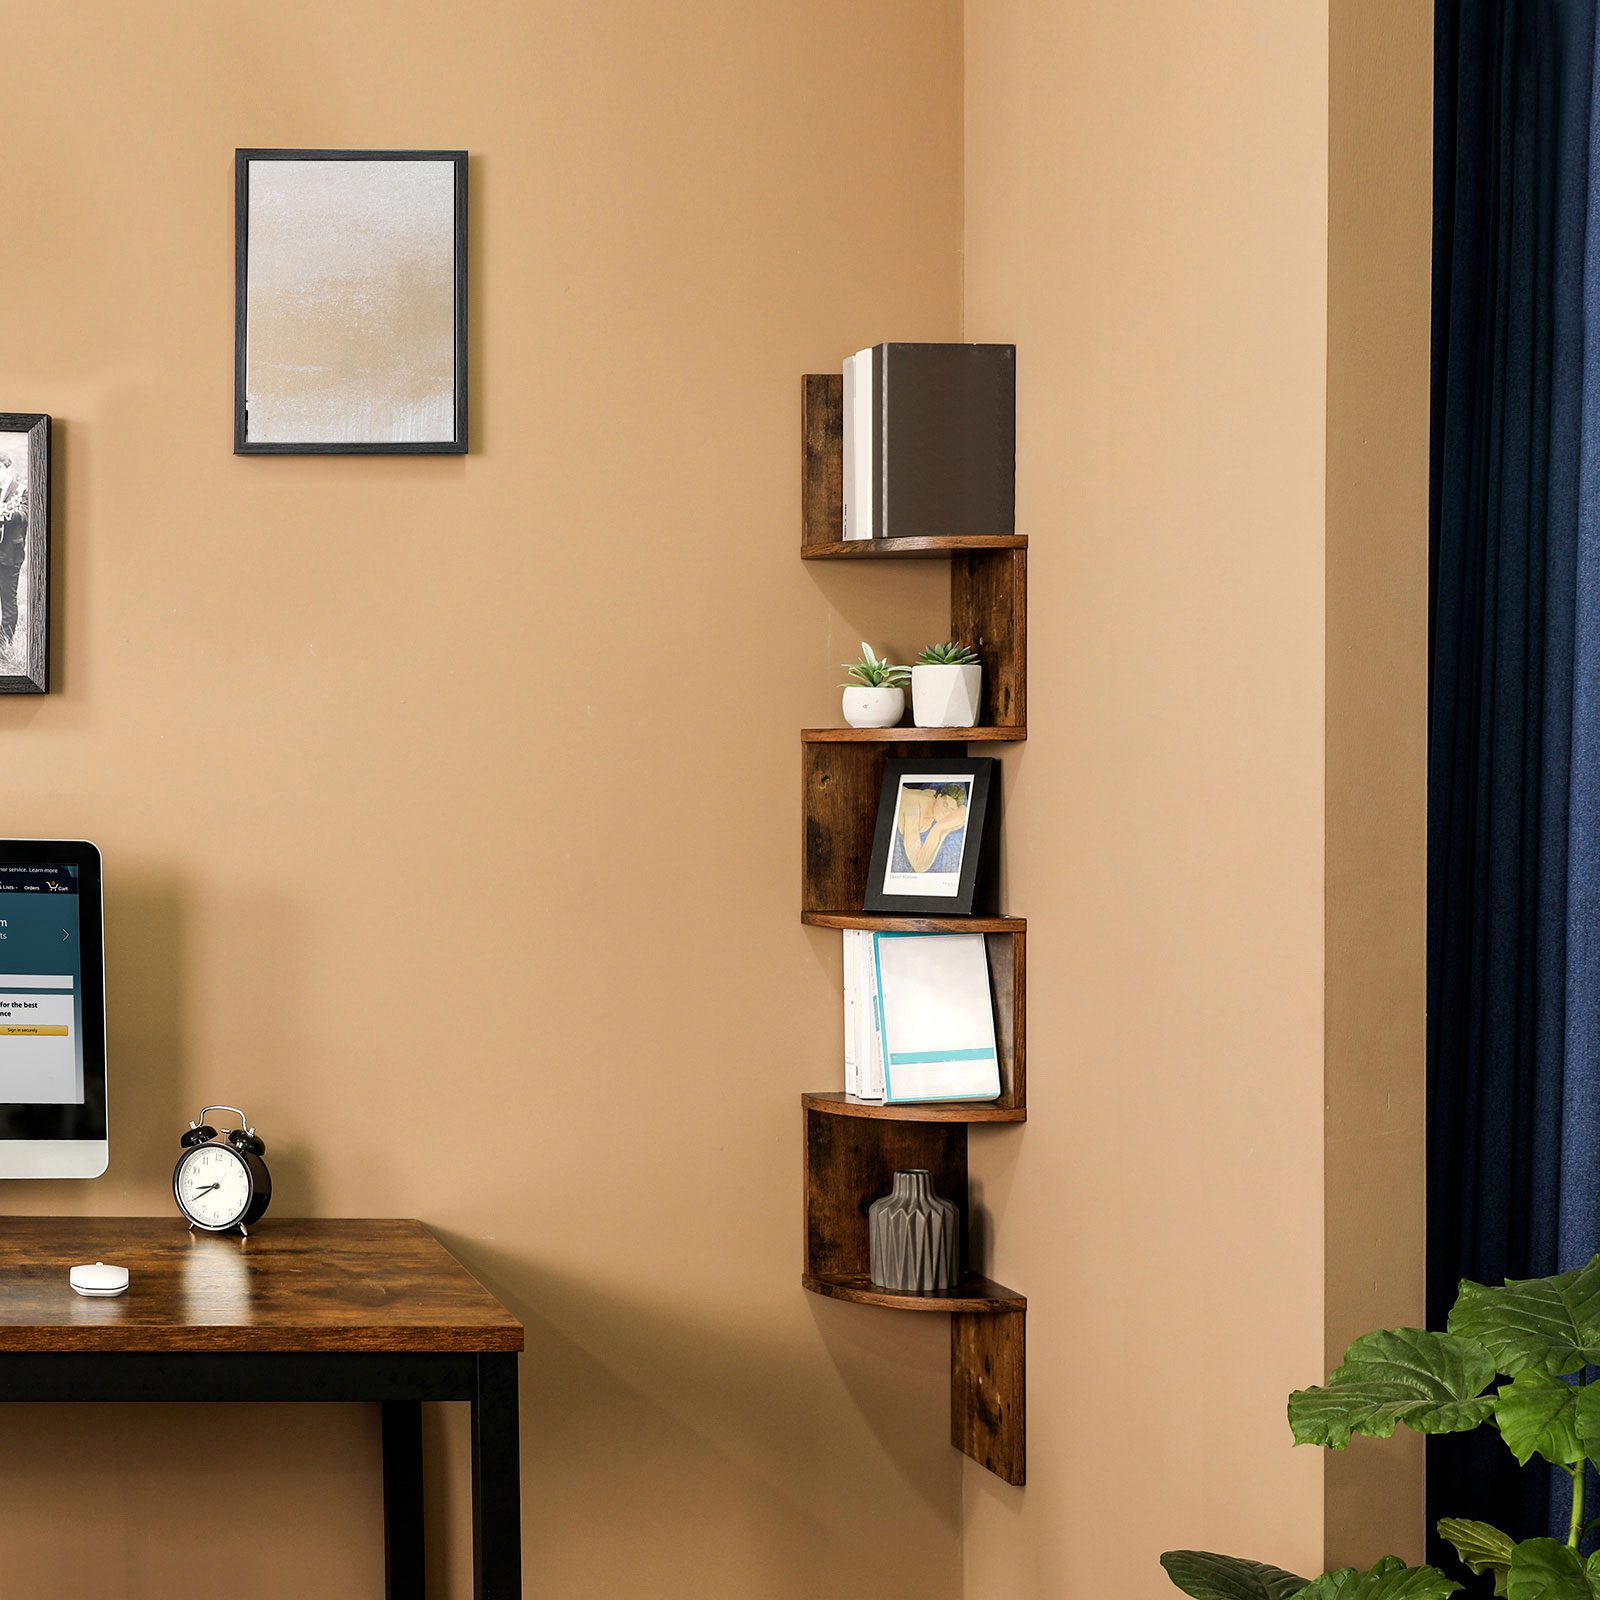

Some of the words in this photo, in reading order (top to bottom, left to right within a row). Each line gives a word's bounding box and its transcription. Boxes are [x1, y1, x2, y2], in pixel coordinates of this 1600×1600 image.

[202, 1156, 209, 1165] 11
[215, 1153, 223, 1161] 12
[192, 1166, 200, 1174] 10
[239, 1169, 244, 1178] 2
